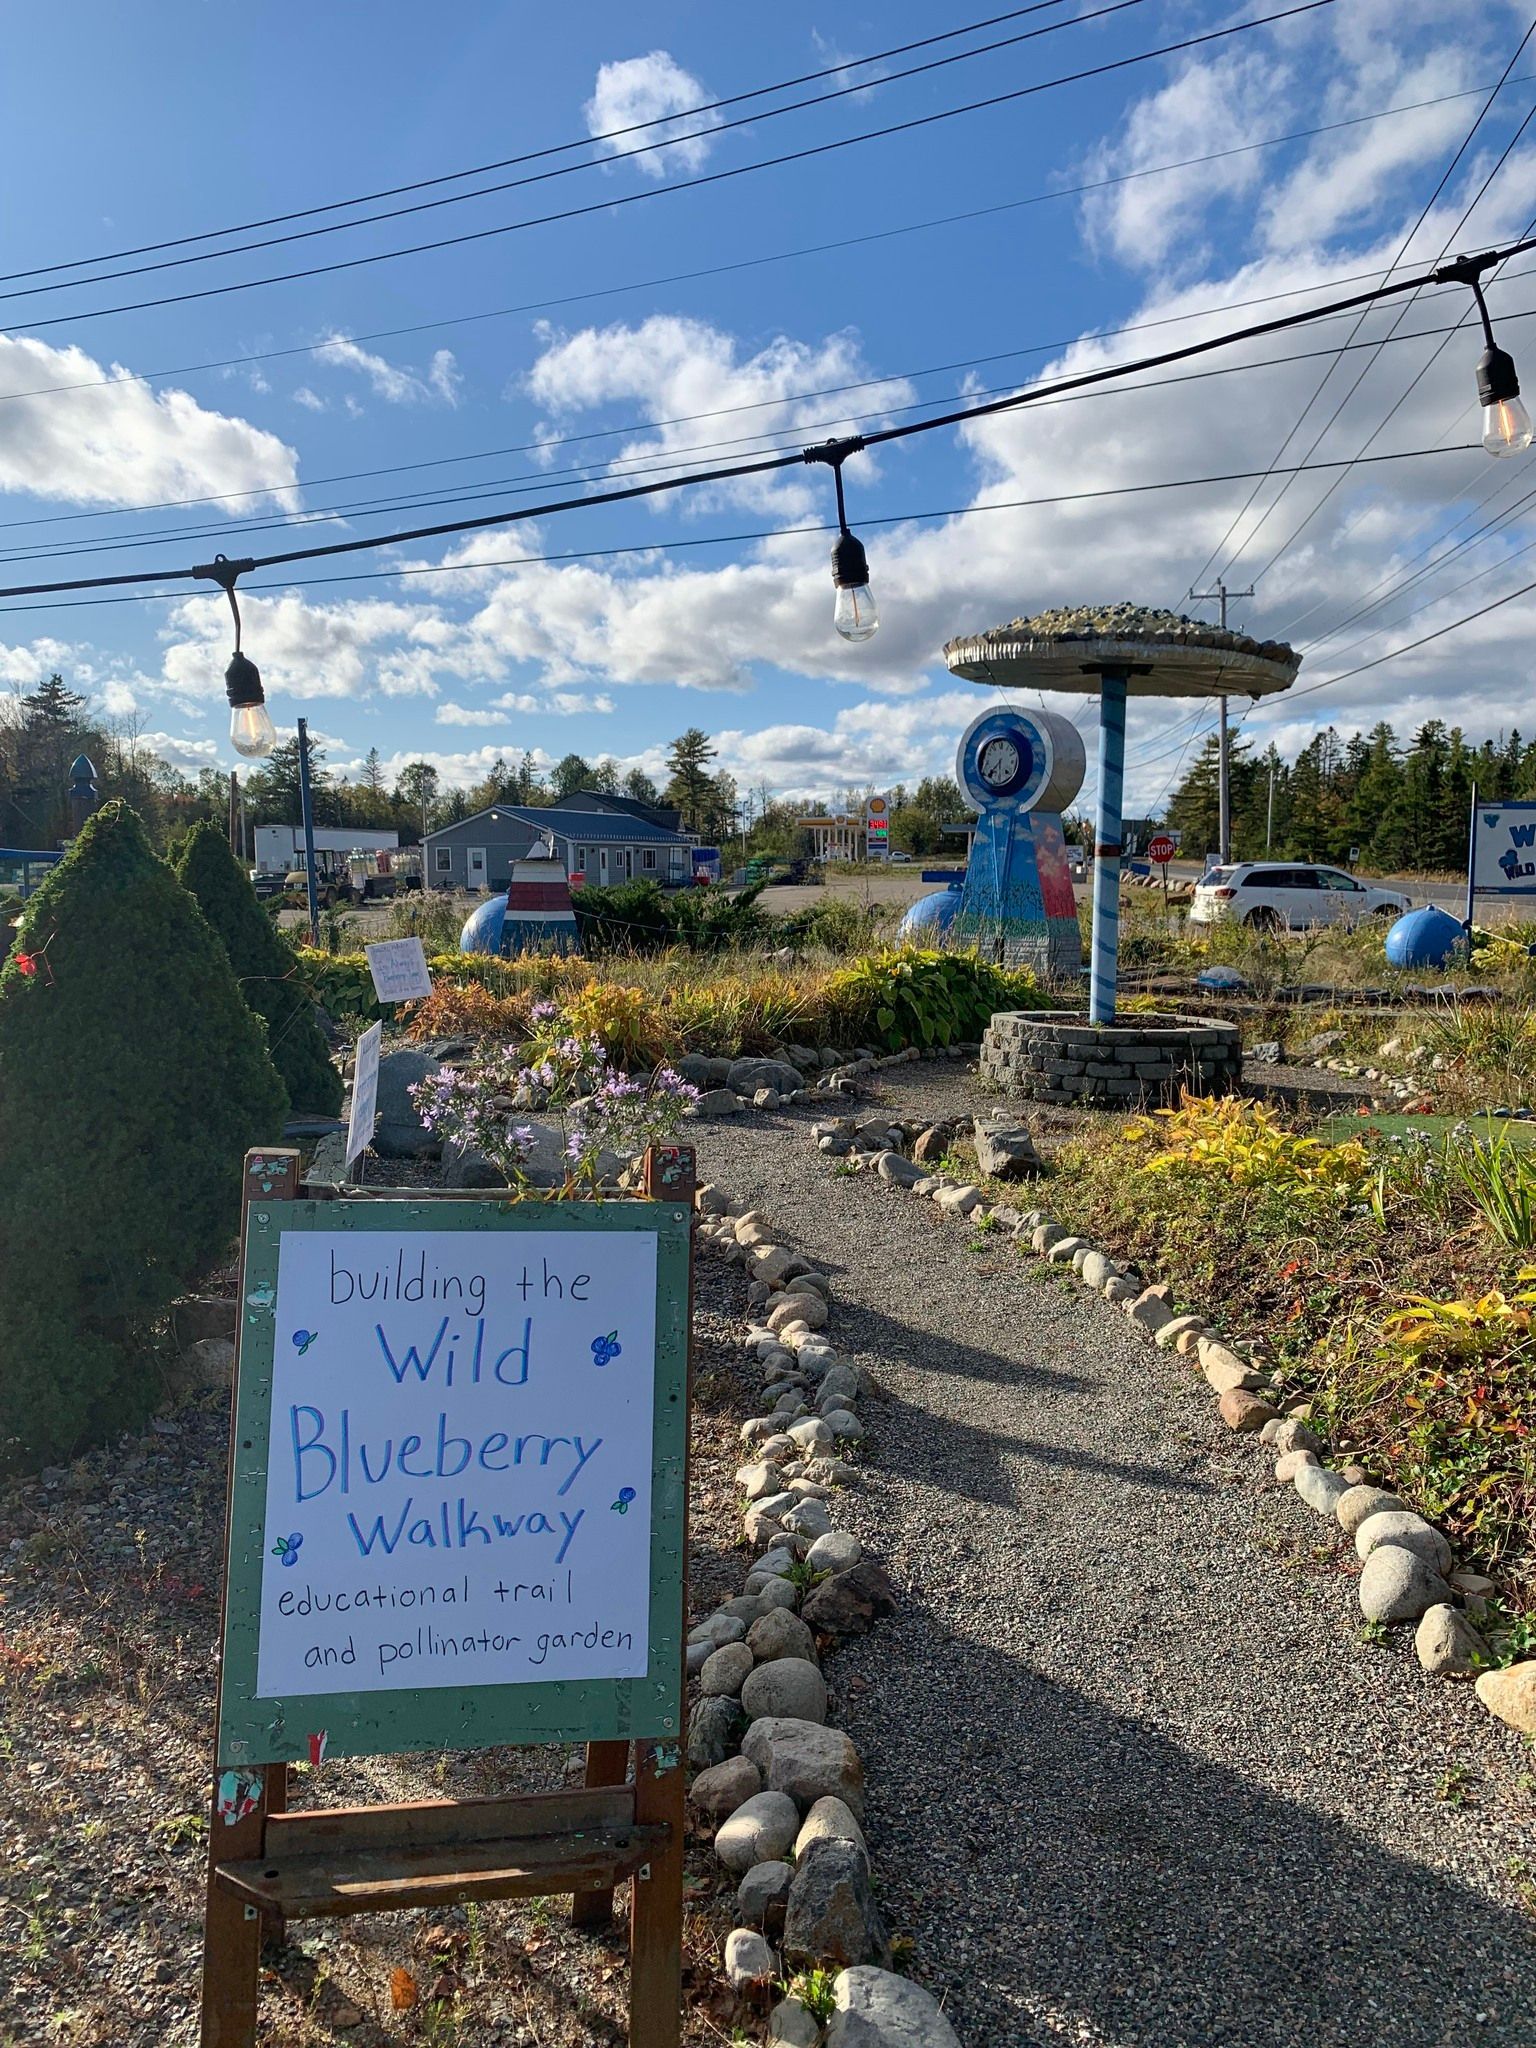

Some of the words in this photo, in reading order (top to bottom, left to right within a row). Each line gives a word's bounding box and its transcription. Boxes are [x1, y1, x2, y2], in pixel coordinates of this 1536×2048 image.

[1150, 844, 1173, 857] STOP
[1503, 862, 1535, 881] WILD
[330, 1247, 486, 1317] building
[515, 1257, 592, 1302] the
[374, 1315, 533, 1387] Wild
[289, 1404, 604, 1504] Blueberry
[346, 1497, 586, 1565] Walkway
[277, 1575, 469, 1617] educational
[493, 1569, 573, 1604] trail
[303, 1635, 356, 1668] and
[378, 1626, 522, 1676] pollinator
[528, 1620, 633, 1665] garden
